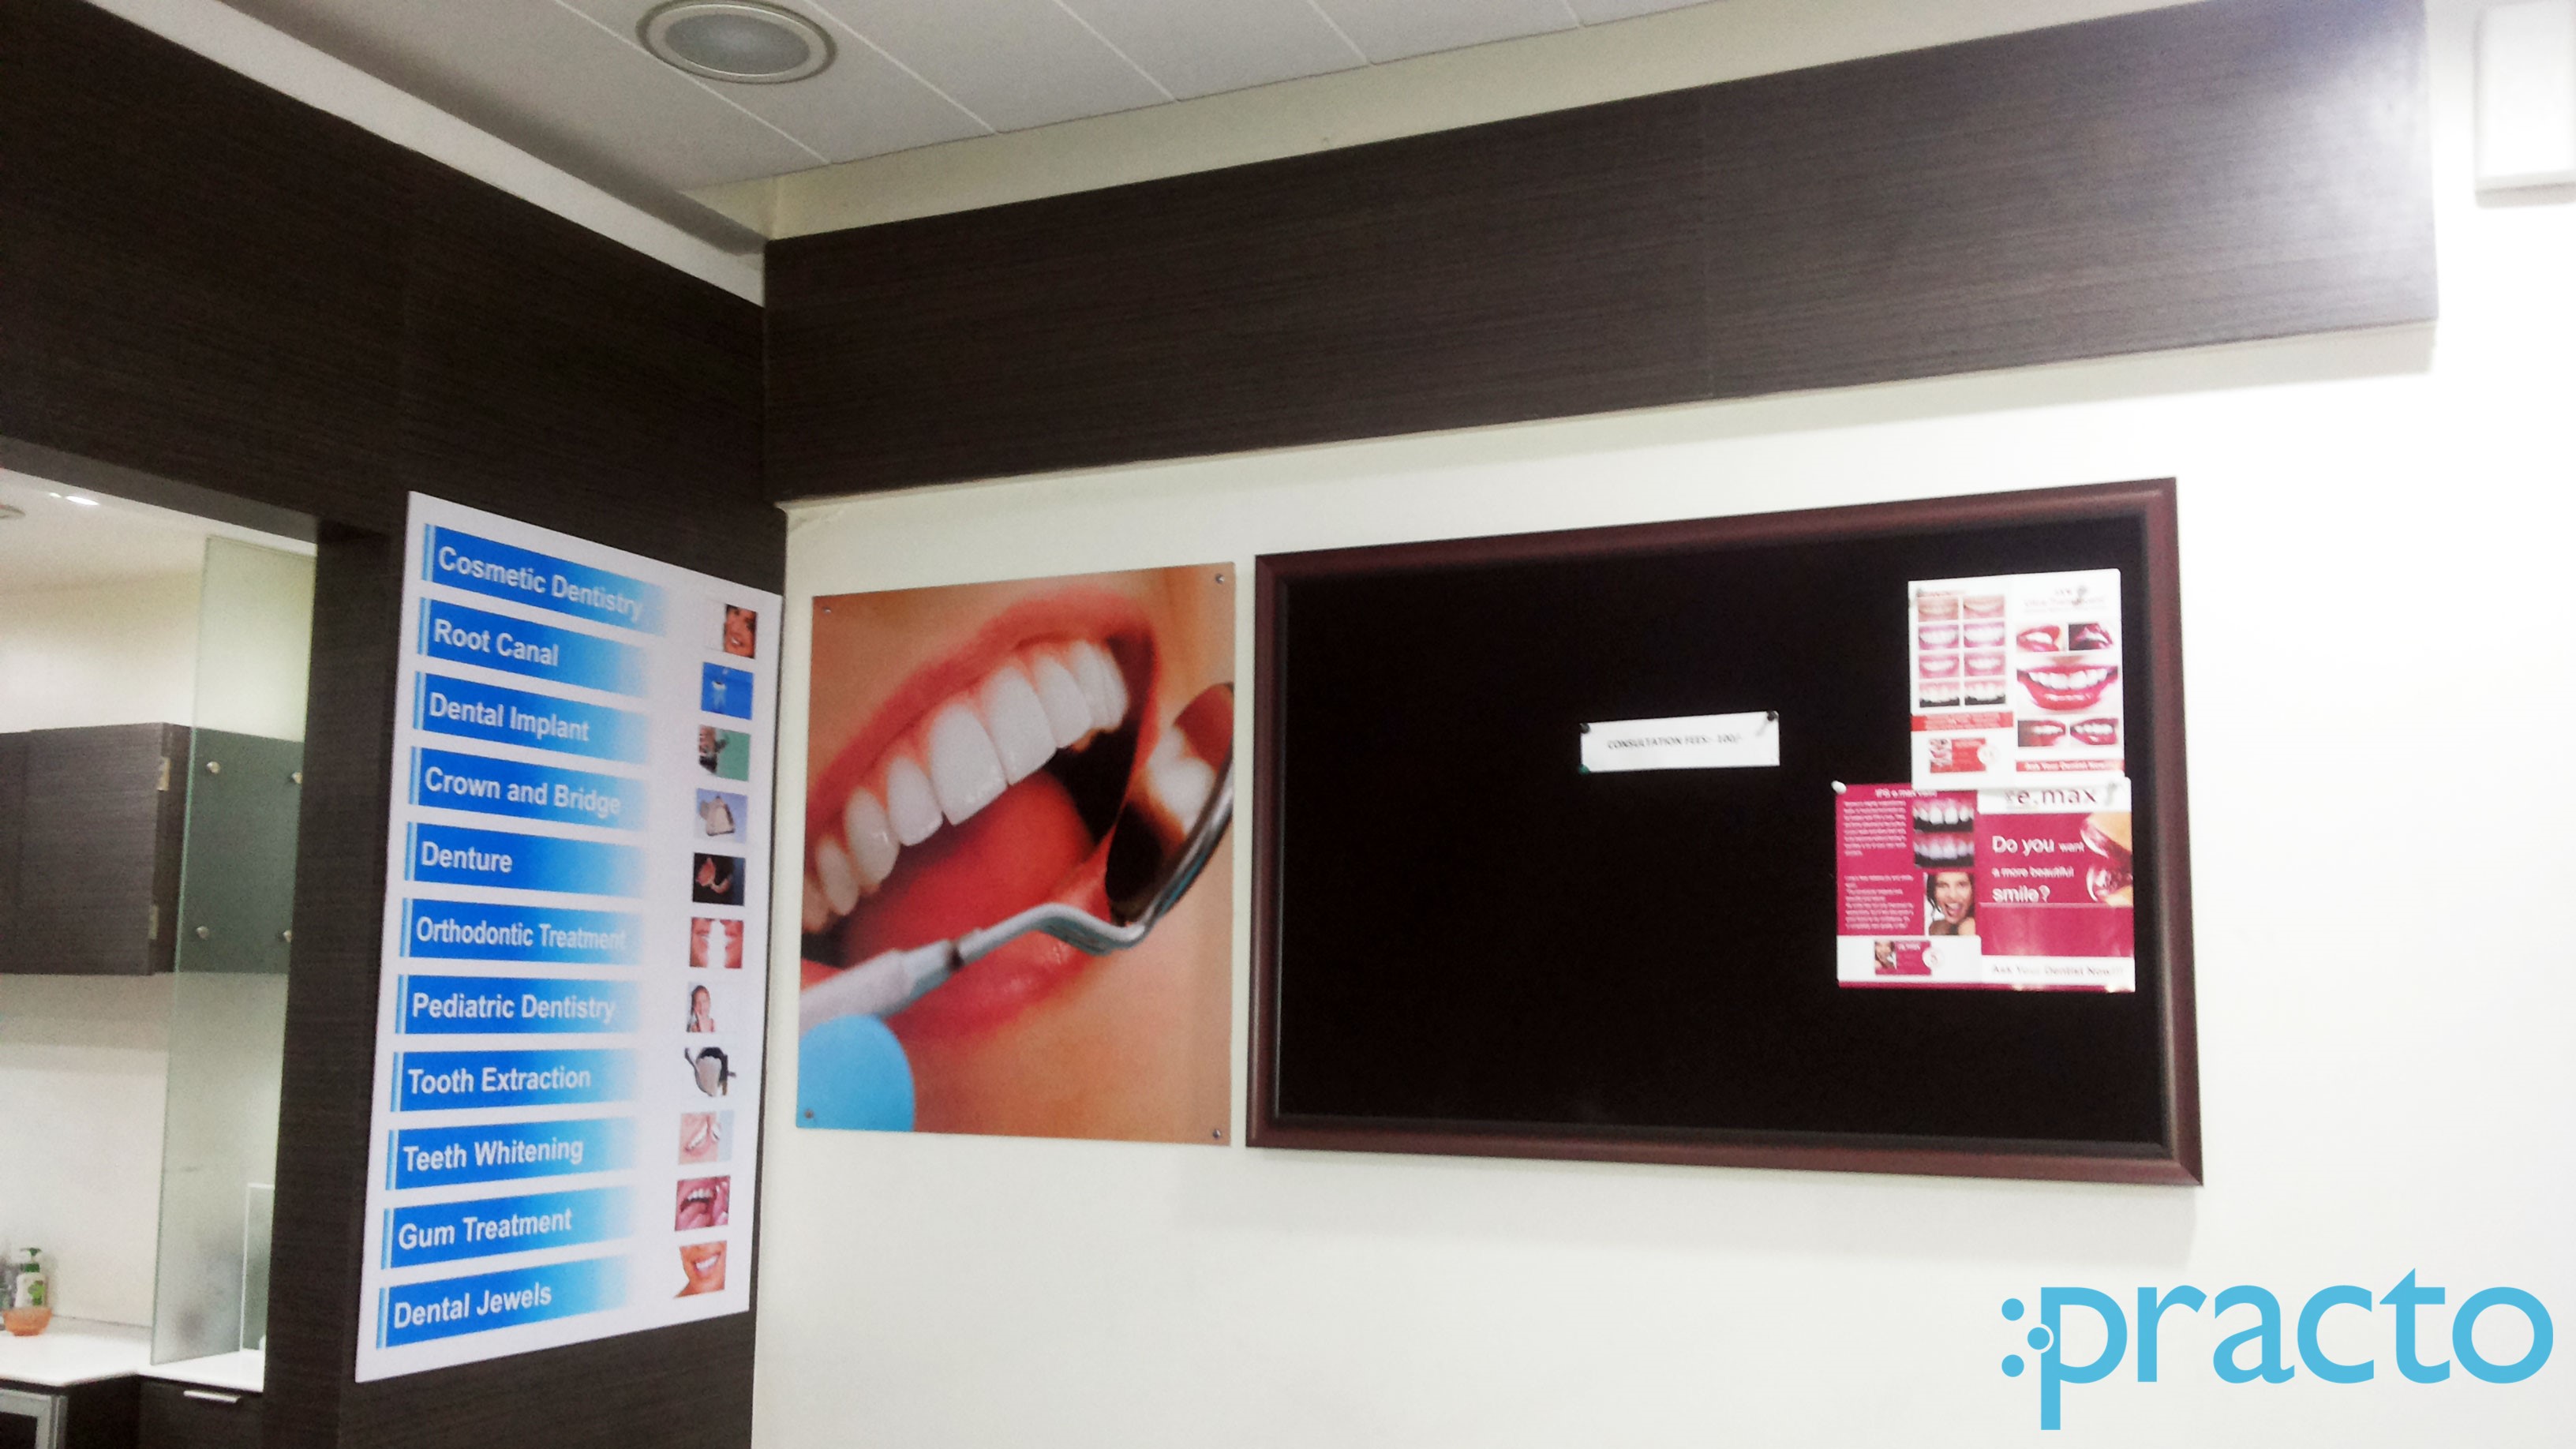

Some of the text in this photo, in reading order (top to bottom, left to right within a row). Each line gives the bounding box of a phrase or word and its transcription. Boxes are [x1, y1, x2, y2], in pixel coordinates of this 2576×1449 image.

[438, 545, 643, 623] Cosmetic Dentistry
[433, 619, 560, 667] Root Canal
[429, 692, 590, 742] Dental Implant
[425, 766, 621, 819] Crown and Bridge
[421, 841, 512, 873] Denture
[1992, 835, 2085, 856] Do you want
[1991, 866, 2075, 878] a more beautiful
[1992, 884, 2051, 903] smile?
[416, 915, 627, 949] Orthodontic Treatment
[412, 992, 616, 1024] Pediatric Dentistry
[407, 1065, 592, 1095] Tooth Extraction
[403, 1136, 584, 1172] Teeth Whitening
[399, 1208, 573, 1249] Gum Treatment
[394, 1282, 552, 1330] Dental Jewels
